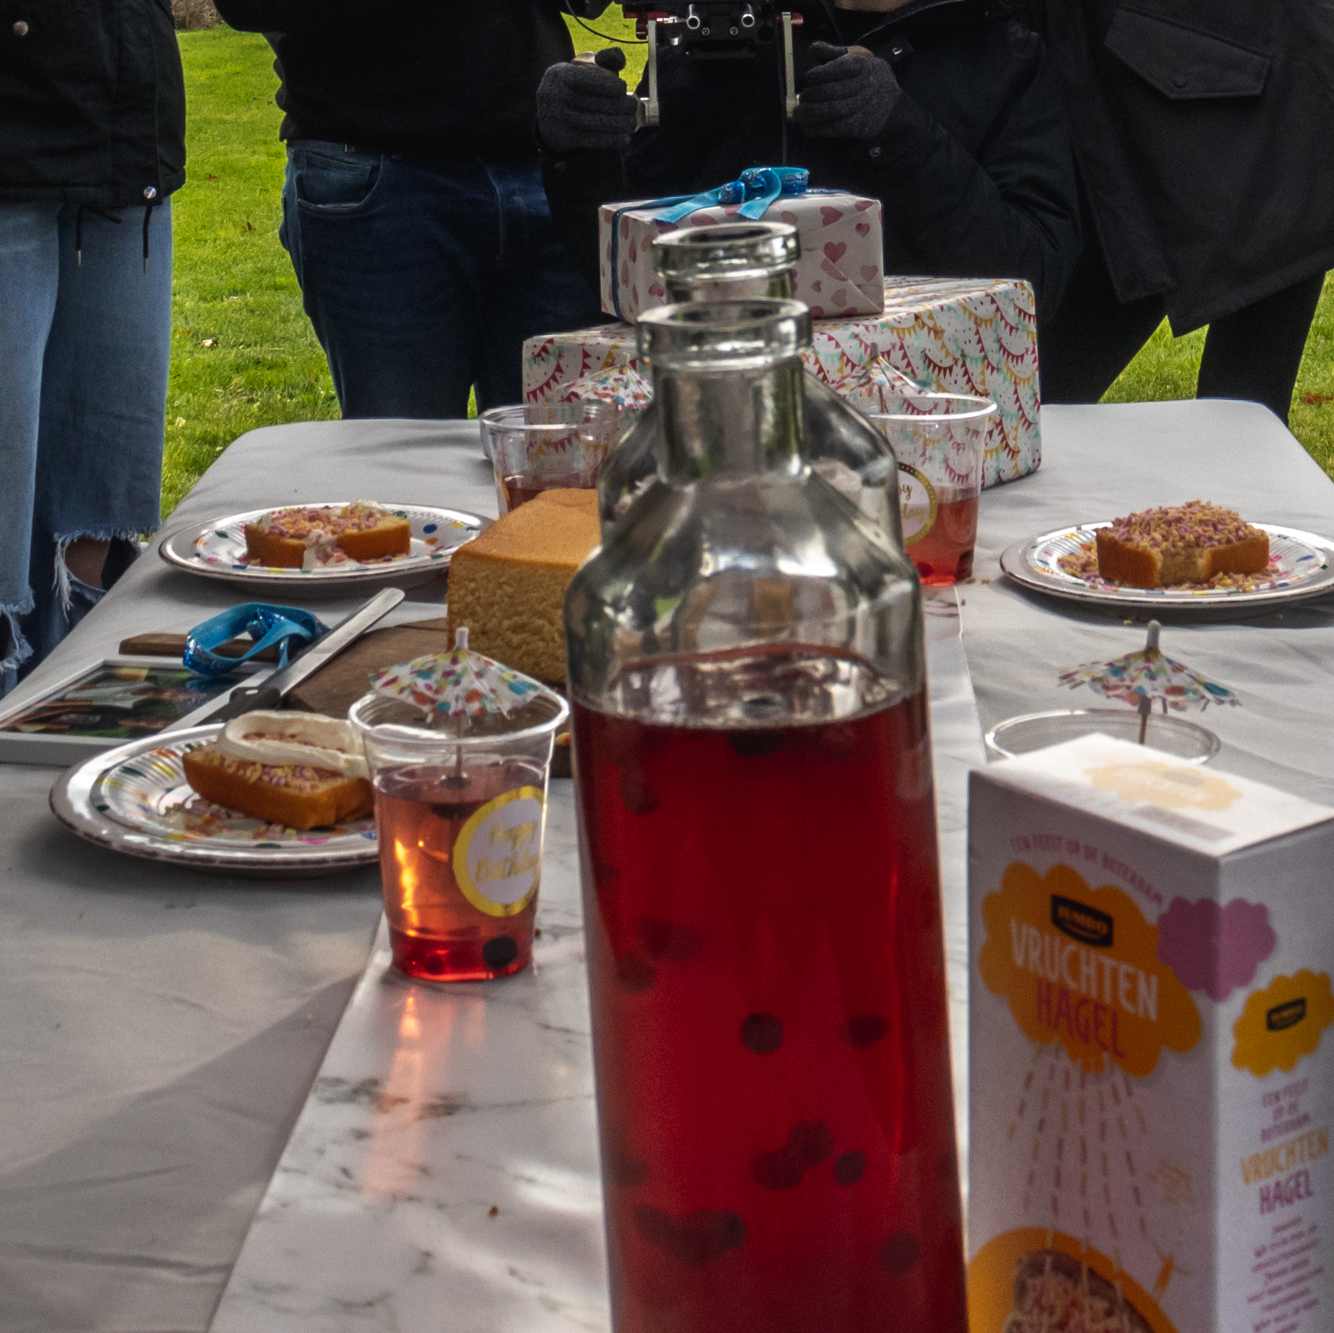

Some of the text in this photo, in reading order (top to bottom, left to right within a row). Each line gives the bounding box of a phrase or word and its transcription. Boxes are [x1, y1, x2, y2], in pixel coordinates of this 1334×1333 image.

[1057, 904, 1109, 938] JUMBO
[1010, 918, 1159, 1022] VRUCHTEN
[1036, 976, 1126, 1059] HAGEL
[1240, 1127, 1330, 1186] VRUCHTEN
[1259, 1167, 1314, 1215] HAGEL
